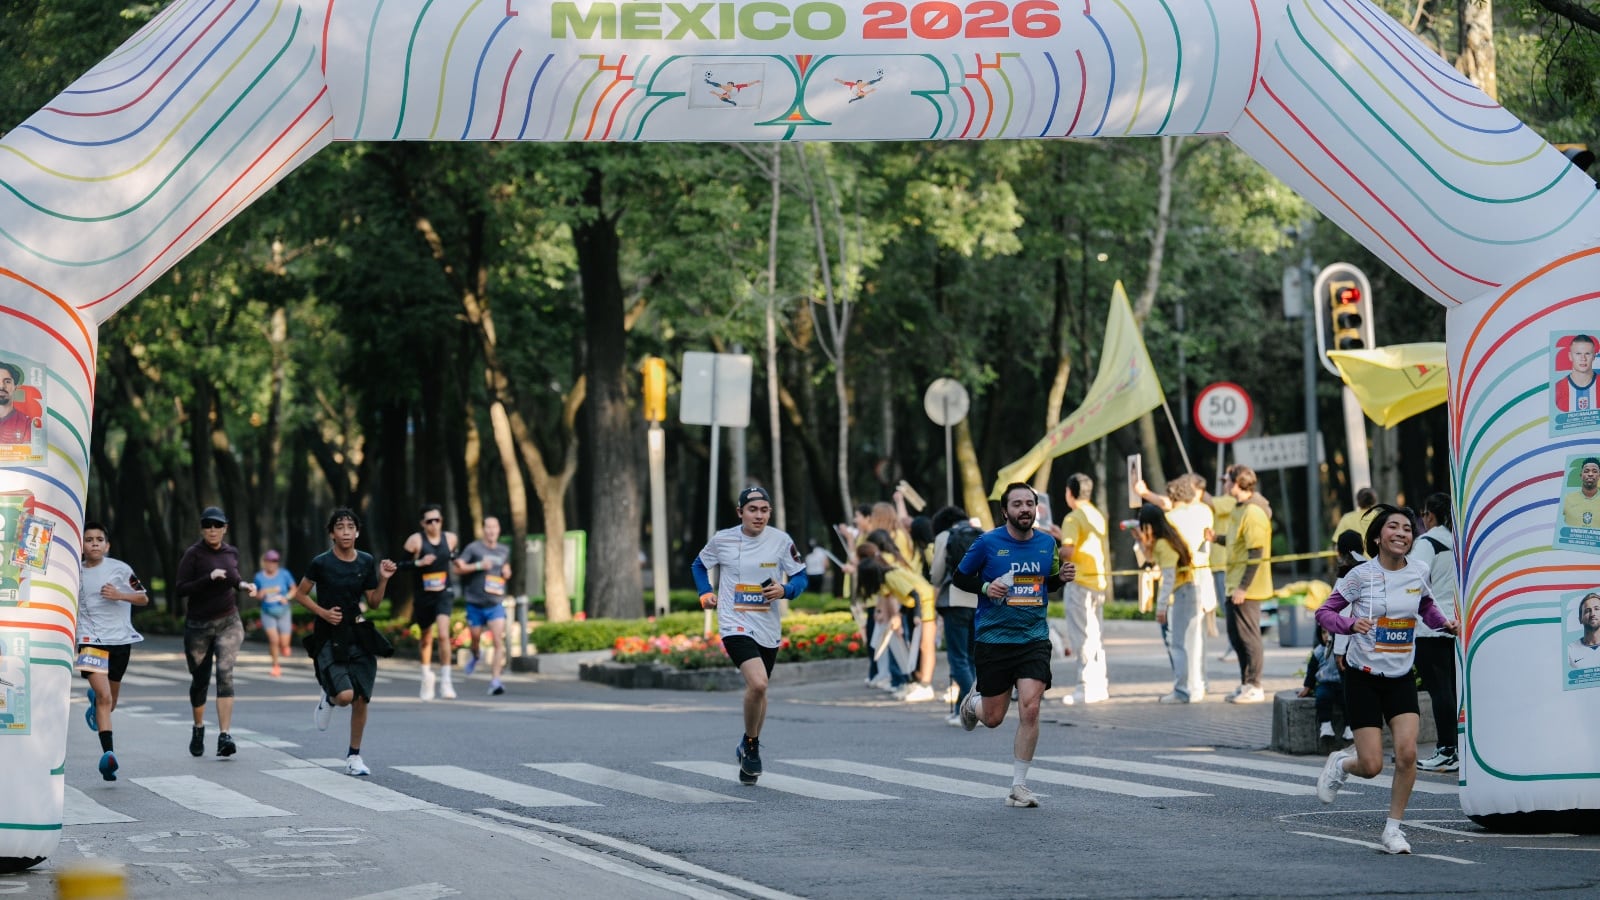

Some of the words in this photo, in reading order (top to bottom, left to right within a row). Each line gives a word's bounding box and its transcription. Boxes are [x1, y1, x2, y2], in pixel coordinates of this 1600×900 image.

[551, 0, 847, 40] MÉXICO
[863, 0, 1061, 40] 2026
[1209, 395, 1236, 415] 50
[1010, 561, 1041, 573] DAN
[1013, 586, 1034, 594] 1979
[743, 594, 763, 602] 1003
[1386, 632, 1407, 640] 1062
[83, 656, 101, 666] 4291
